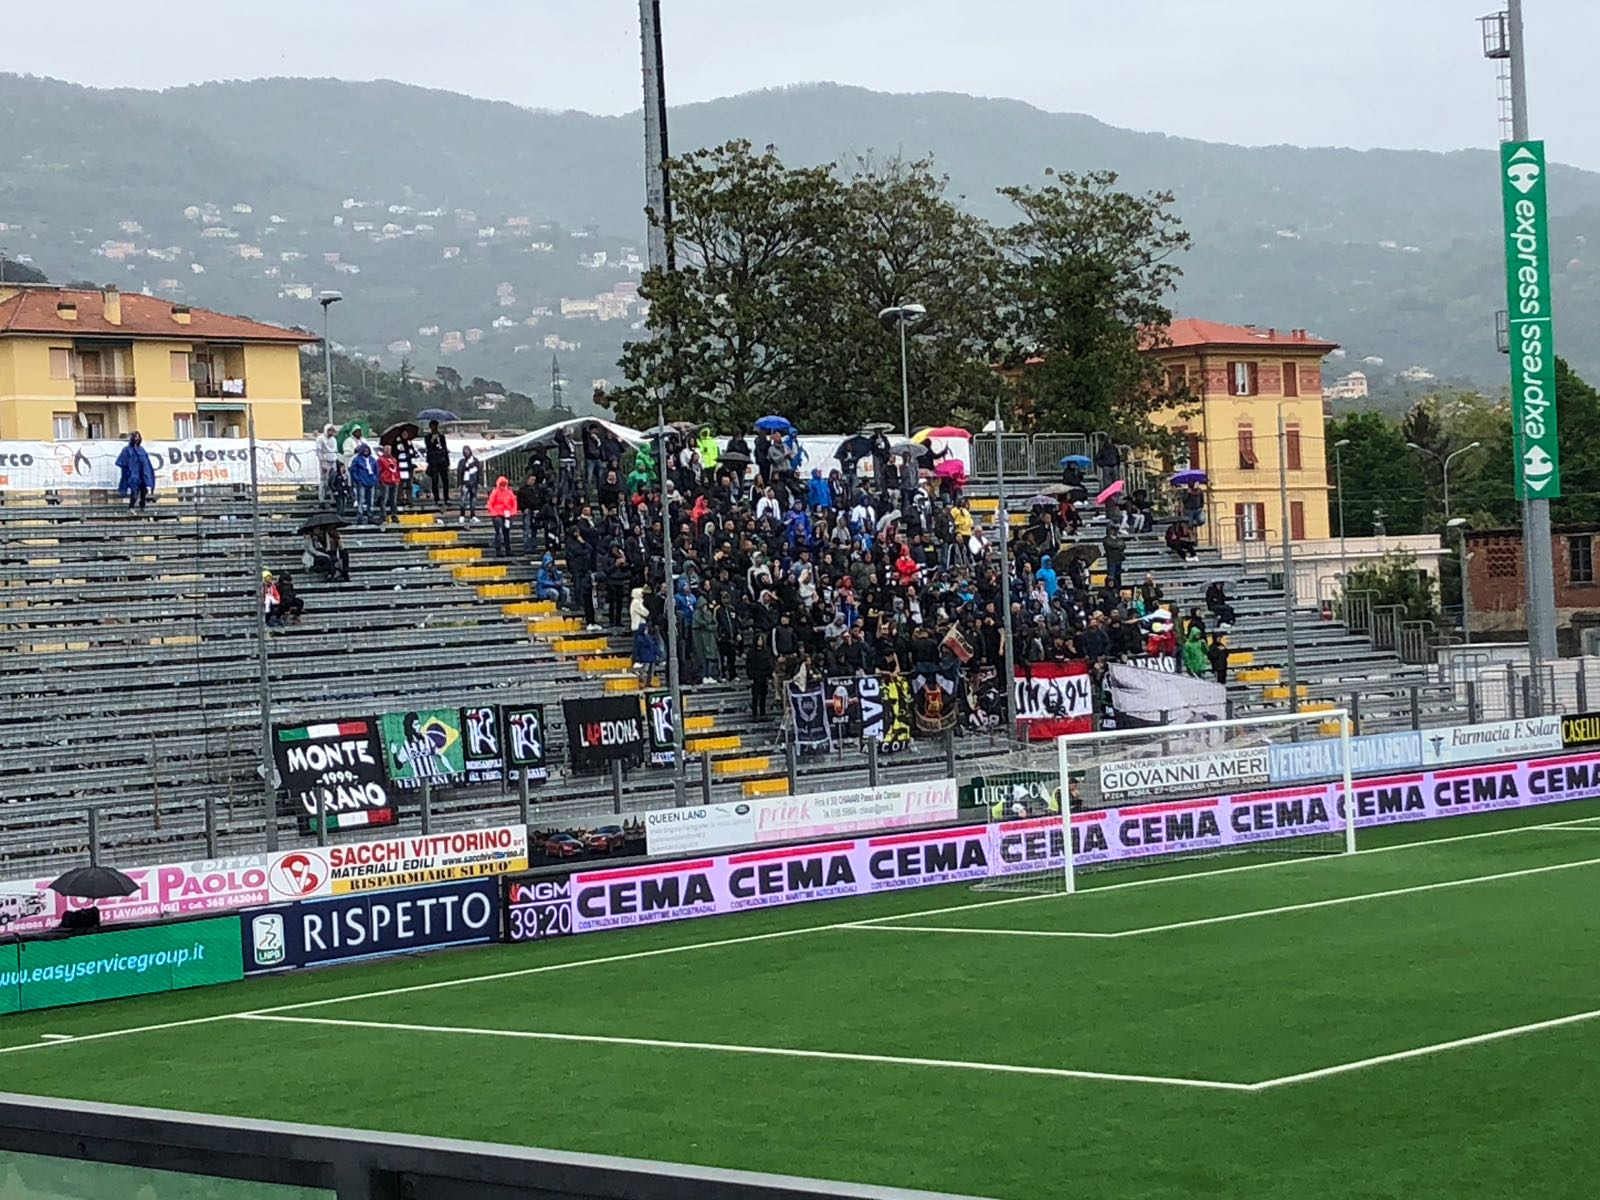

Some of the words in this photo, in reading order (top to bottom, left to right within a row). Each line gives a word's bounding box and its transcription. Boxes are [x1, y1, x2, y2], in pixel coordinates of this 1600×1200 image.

[1510, 199, 1540, 315] express
[1521, 322, 1550, 440] express
[1065, 678, 1089, 711] 94
[1452, 727, 1510, 746] Farmacia
[1525, 719, 1560, 738] Solari
[287, 740, 375, 773] MONTE
[1334, 735, 1420, 772] LGOMARSINO
[1103, 765, 1201, 789] GIOVANNI
[1206, 756, 1268, 779] AMERI
[300, 782, 387, 814] URANO
[904, 788, 954, 814] prink
[1336, 785, 1425, 820] CEMA
[1434, 774, 1519, 807] CEMA
[648, 814, 680, 825] QUEEN
[682, 809, 707, 820] LAND
[758, 801, 811, 830] prink
[1119, 809, 1221, 847] CEMA
[1230, 796, 1330, 834] CEMA
[329, 841, 405, 868] SACCHI
[411, 829, 512, 858] VITTORINO
[869, 839, 989, 880] CEMA
[1001, 823, 1109, 863] CEMA
[202, 856, 262, 871] DITTA
[331, 861, 398, 879] MATERIALI
[402, 857, 435, 871] EDILI
[350, 870, 456, 890] RISPARMIARE
[459, 865, 477, 876] SI
[729, 856, 857, 898] CEMA
[157, 867, 266, 902] PAOLO
[577, 873, 716, 918] CEMA
[113, 905, 159, 919] LAVAGNA
[303, 891, 491, 952] RISPETTO
[510, 904, 571, 940] 39:20
